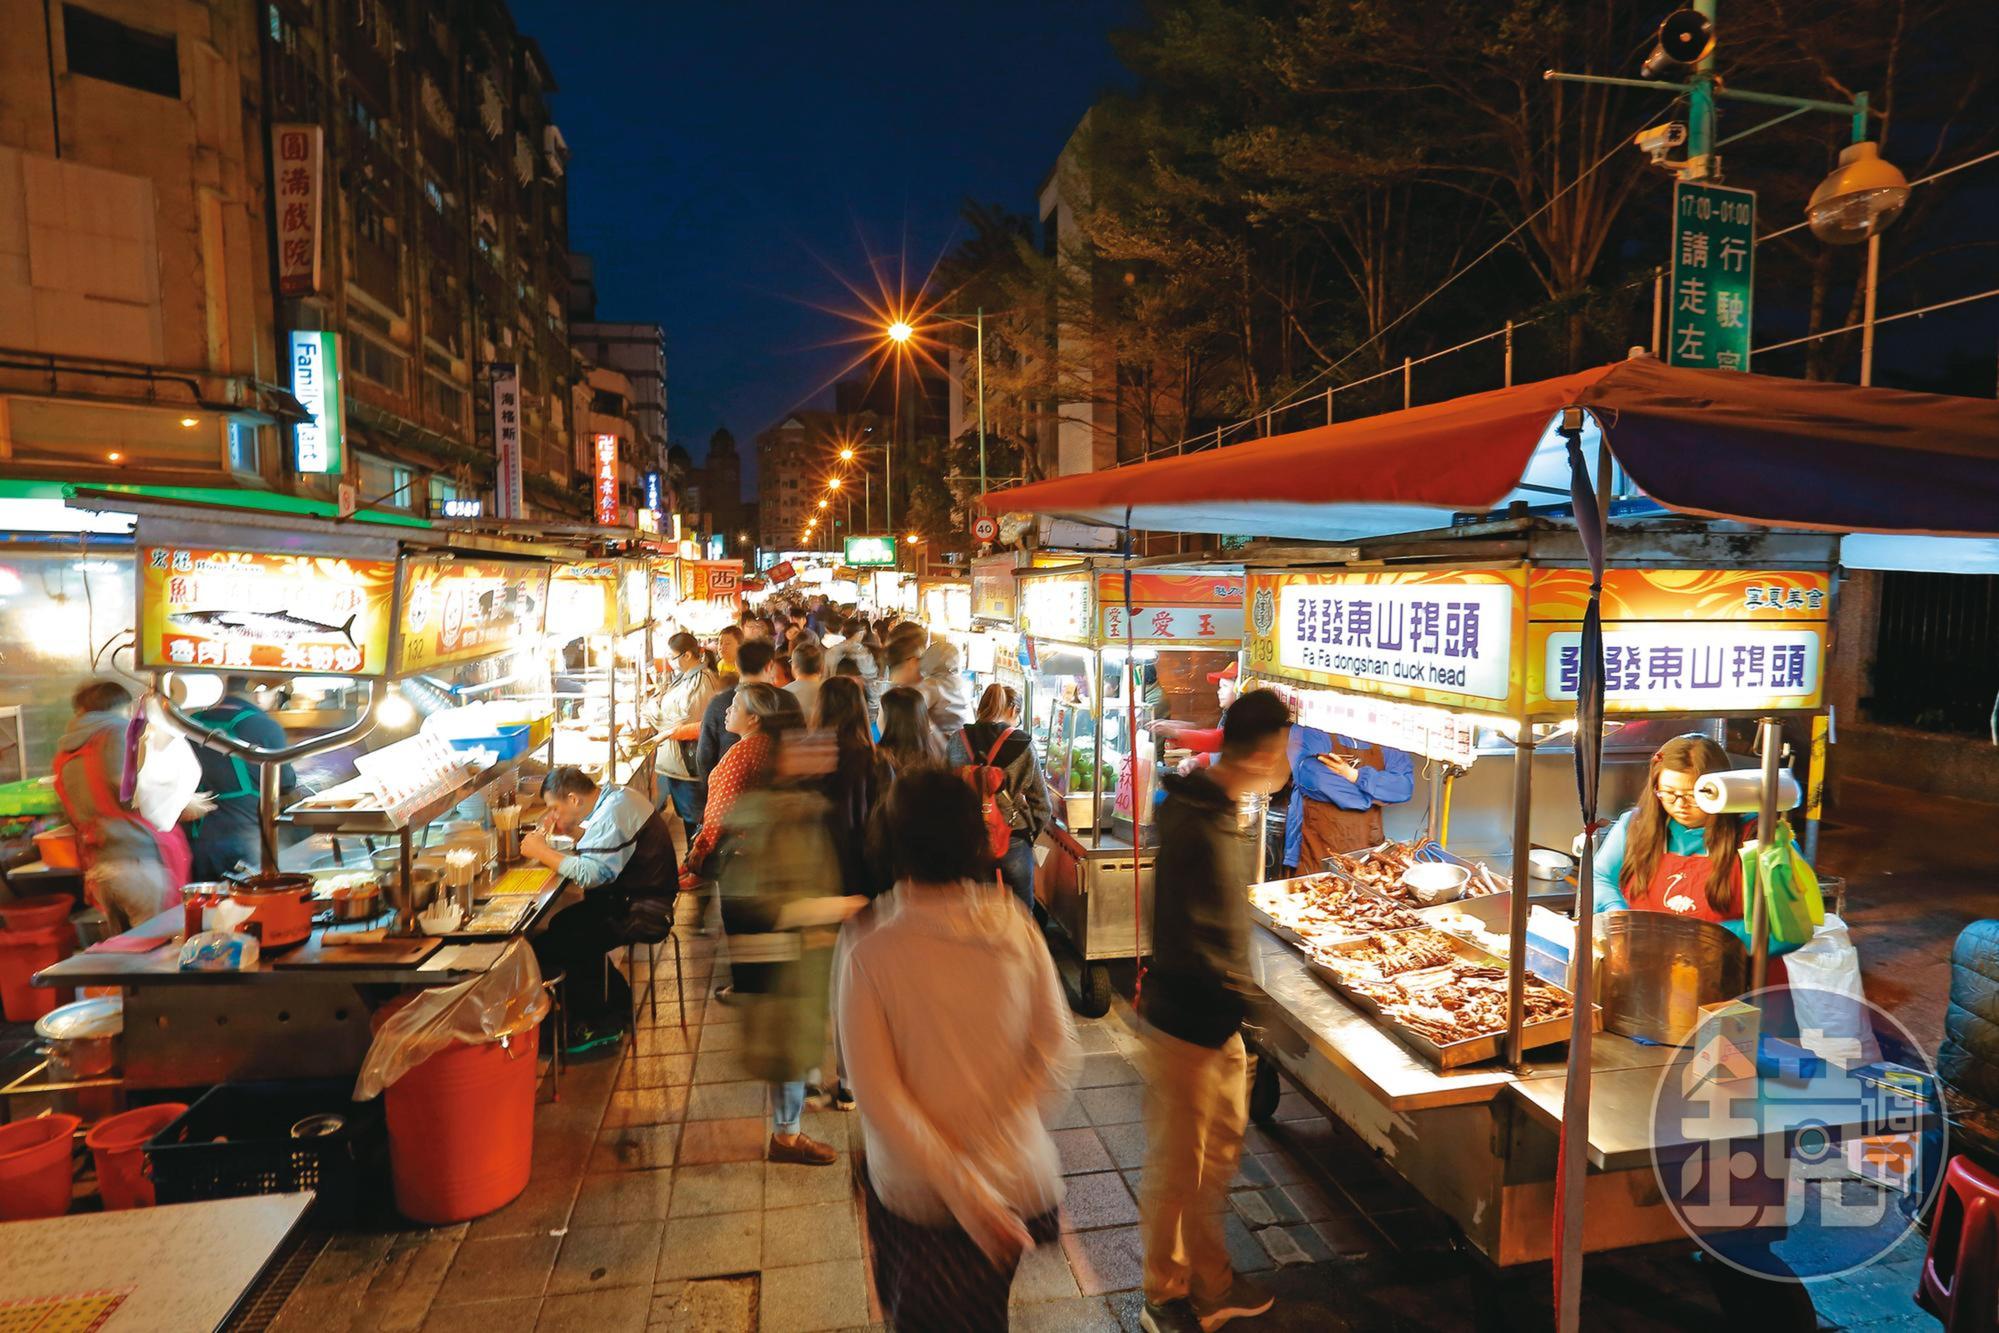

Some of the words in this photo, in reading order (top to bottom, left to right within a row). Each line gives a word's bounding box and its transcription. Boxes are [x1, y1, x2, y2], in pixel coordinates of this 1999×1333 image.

[1676, 230, 1709, 360] 請走左
[978, 524, 992, 534] 40
[1107, 607, 1122, 638] 愛玉
[1151, 611, 1217, 638] 愛玉
[407, 639, 424, 662] 132
[1253, 639, 1273, 662] 139
[1303, 648, 1315, 665] Fa
[1318, 649, 1331, 667] Fa
[1334, 651, 1389, 676] dongshan
[1393, 660, 1425, 682] duck
[1429, 665, 1466, 687] head
